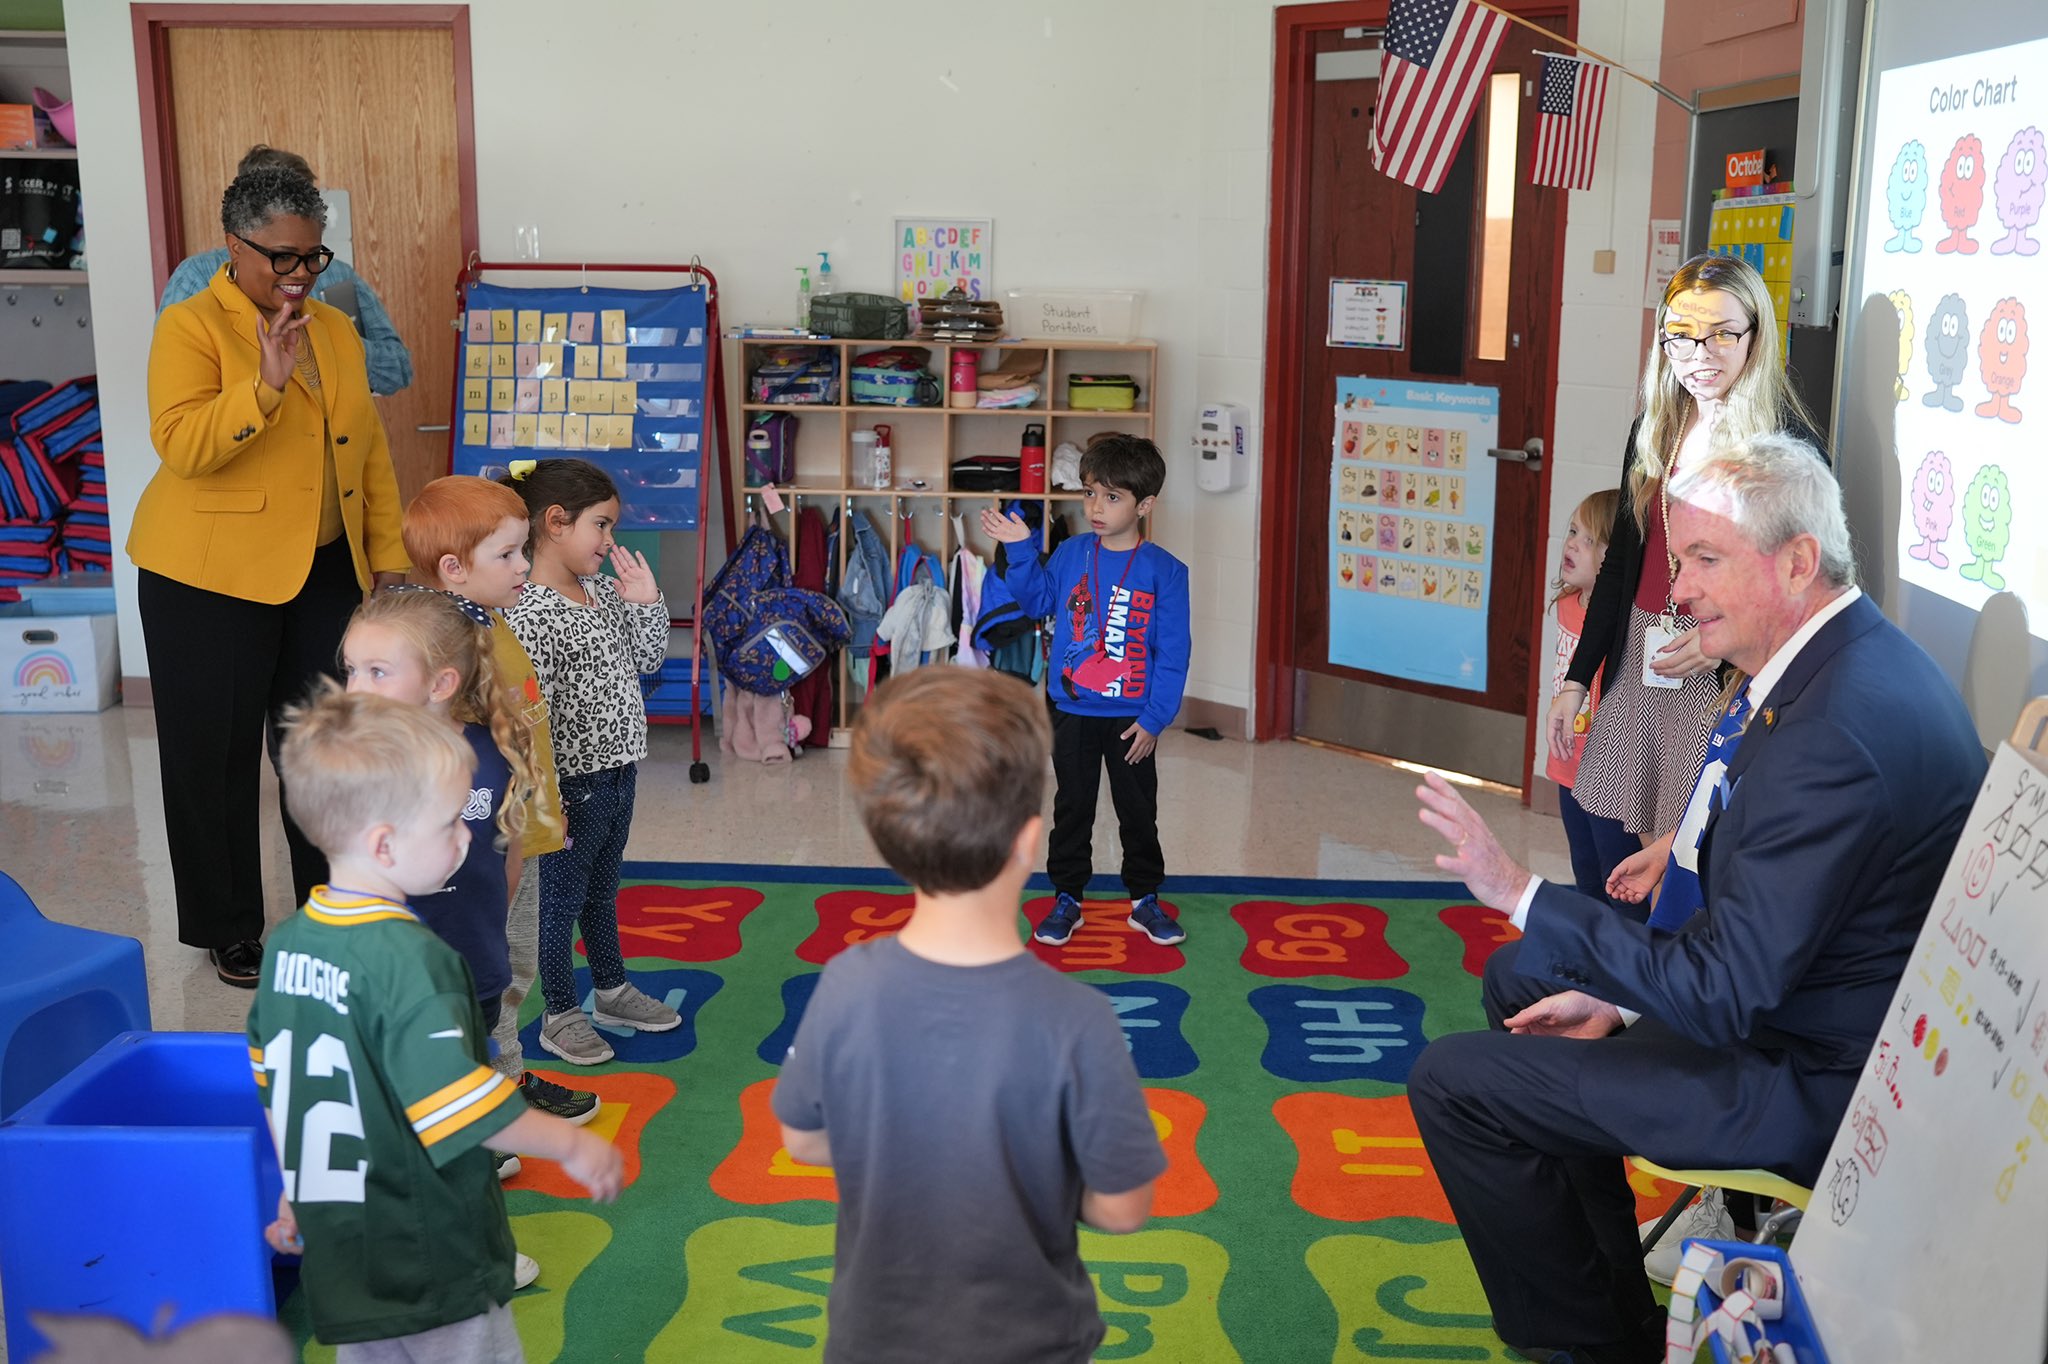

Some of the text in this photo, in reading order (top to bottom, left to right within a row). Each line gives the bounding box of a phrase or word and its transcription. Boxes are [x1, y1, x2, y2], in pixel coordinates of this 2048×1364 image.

[1929, 75, 2018, 113] Color Chart
[1728, 153, 1763, 177] Octobe
[1954, 206, 1966, 217] Red
[2009, 202, 2031, 217] Purple
[1042, 303, 1090, 318] Student
[1042, 319, 1098, 334] Portfolios
[1939, 363, 1954, 377] Grey
[1991, 371, 2014, 389] Orange
[1406, 389, 1491, 406] Basic Keywords
[1346, 424, 1461, 443] Aa Bb Cc Dd Ee Ff
[1342, 467, 1356, 481] Gg
[1364, 469, 1376, 480] Hh
[1406, 473, 1416, 488] Jj
[1427, 475, 1438, 487] Kk
[1339, 510, 1355, 522] Mm
[1361, 513, 1373, 524] Nn
[1380, 515, 1396, 528] Oo
[1403, 518, 1414, 532] Pp
[1446, 523, 1456, 534] Rr
[1469, 526, 1480, 538] Ss
[1925, 516, 1938, 531] Pink
[1976, 535, 1996, 552] Green
[1361, 557, 1373, 568] Uu
[1381, 560, 1394, 570] Vv
[1400, 562, 1416, 573] Ww
[1446, 568, 1457, 582] Yy
[1467, 571, 1478, 583] Zz
[1101, 584, 1131, 698] AMAZG
[1122, 589, 1156, 699] BEYOND
[1256, 913, 1366, 964] Gg
[1294, 1000, 1409, 1064] Hh
[263, 1028, 369, 1203] 12
